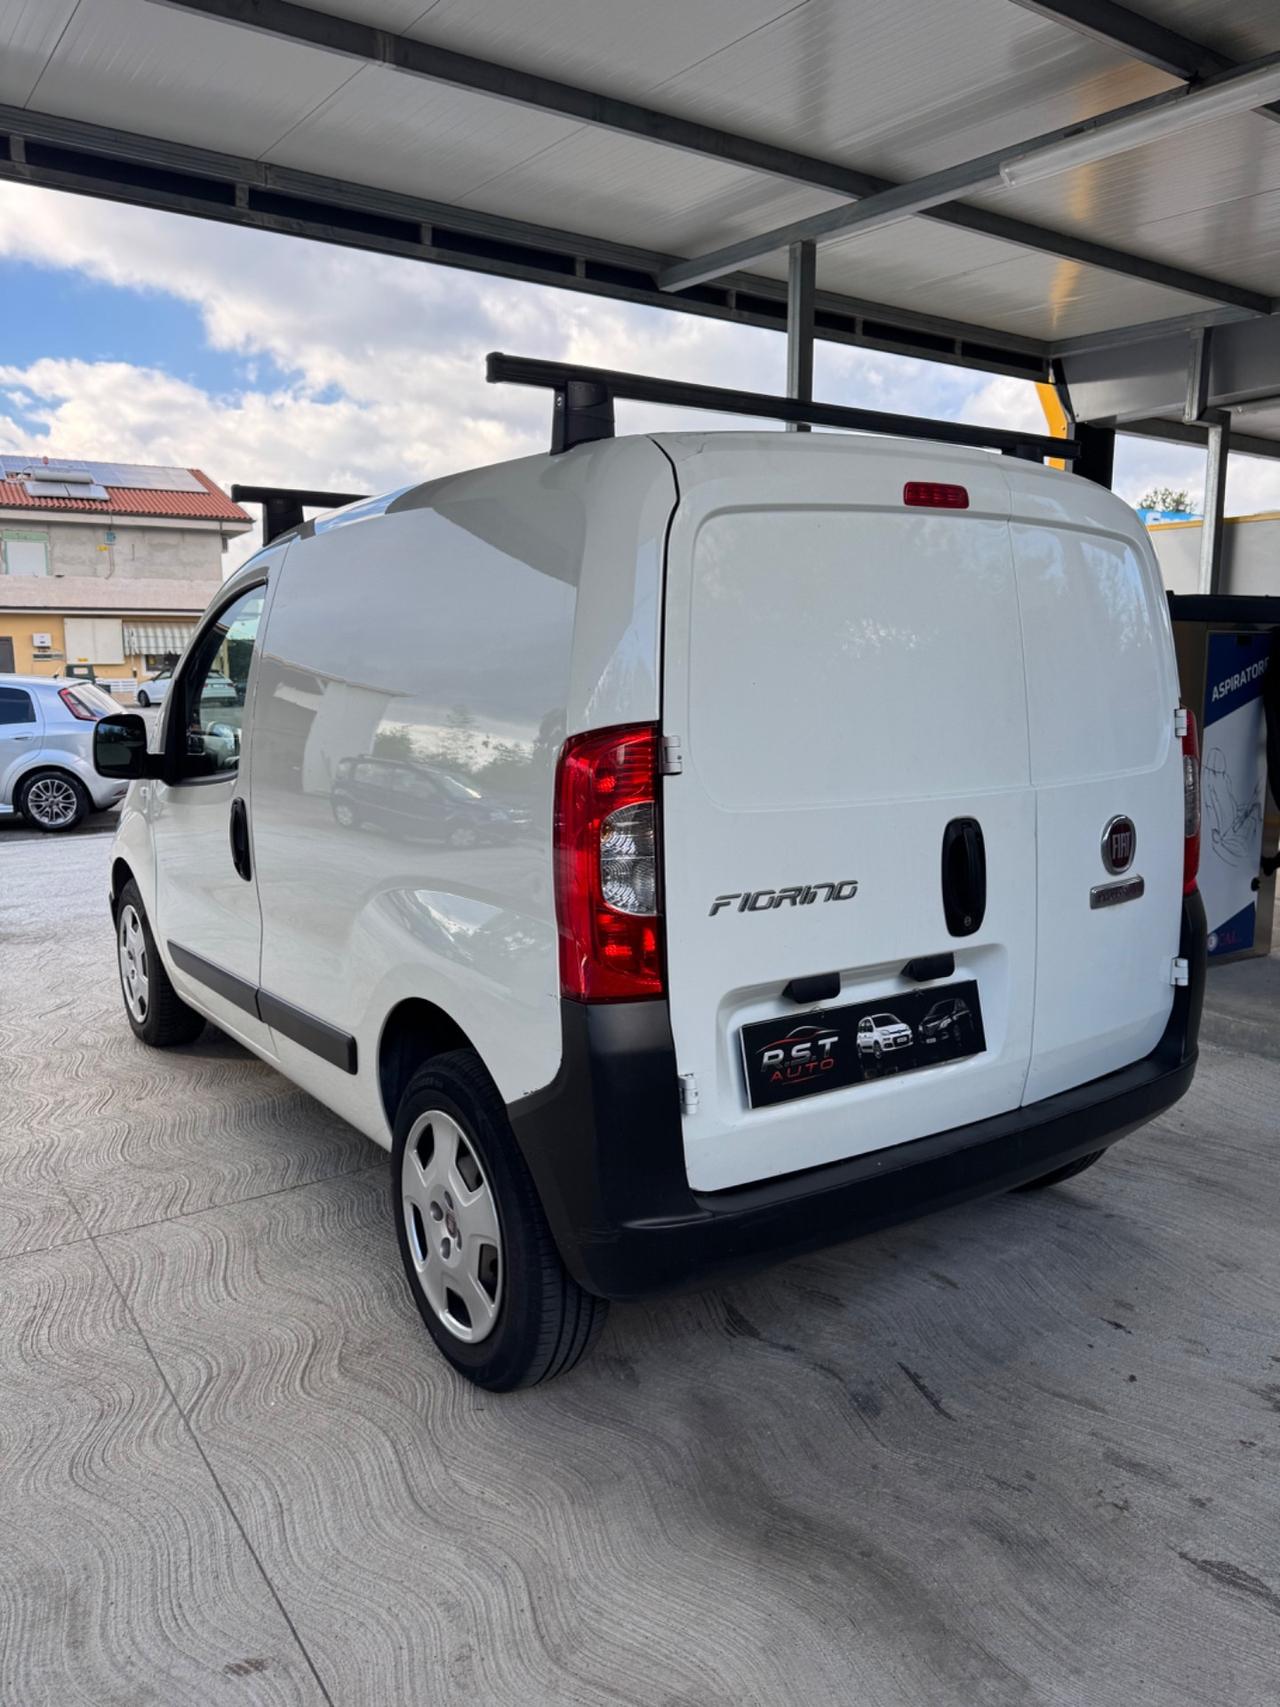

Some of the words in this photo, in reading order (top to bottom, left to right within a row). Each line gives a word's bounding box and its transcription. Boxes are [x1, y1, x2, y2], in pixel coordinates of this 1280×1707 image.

[1112, 831, 1132, 860] FIAT
[708, 879, 858, 917] FIORINO
[769, 1058, 834, 1082] AUTO
